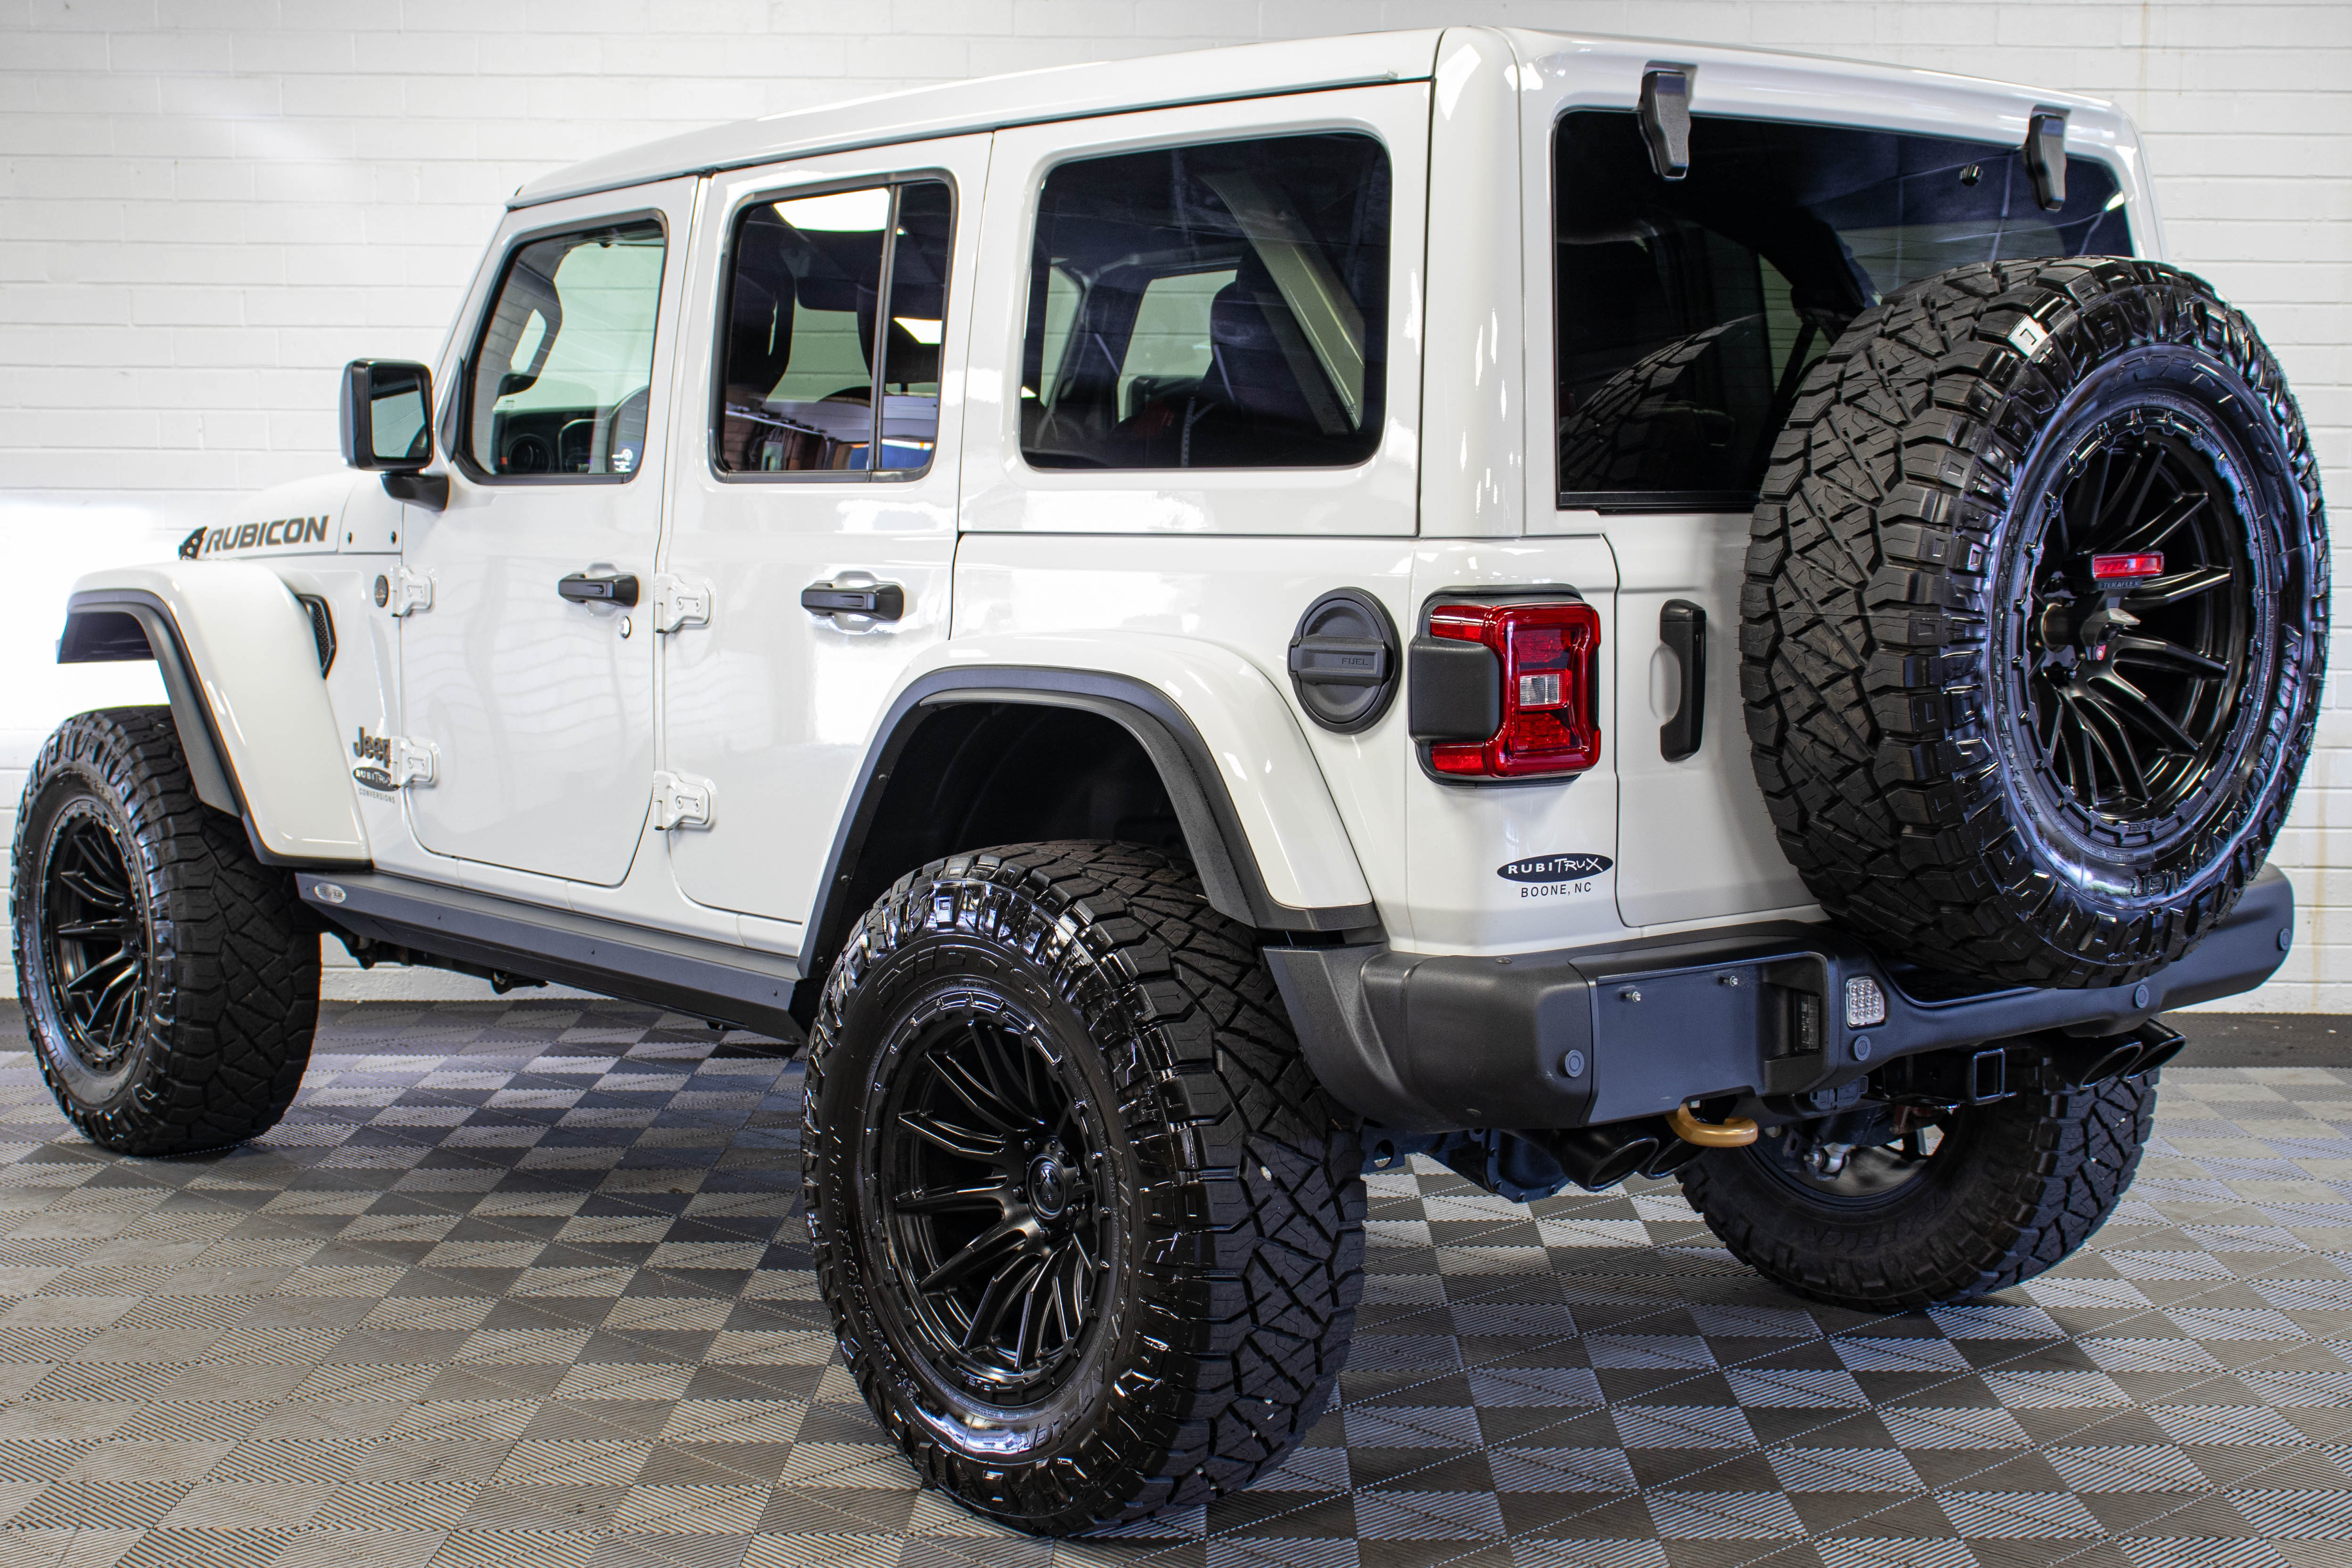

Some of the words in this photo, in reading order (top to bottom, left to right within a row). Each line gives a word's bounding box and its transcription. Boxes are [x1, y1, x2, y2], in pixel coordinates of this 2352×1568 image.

[206, 515, 329, 553] RUBICON
[2104, 580, 2138, 588] TERAFLEX
[2258, 623, 2303, 773] RIDGE
[353, 726, 391, 768] Jeep
[355, 769, 392, 787] RUBITRU
[359, 788, 395, 803] CONVERSIONS
[2130, 762, 2268, 897] GRAPPLER
[1508, 858, 1603, 874] RUBITRUX
[1521, 884, 1570, 898] BOONE,
[1575, 882, 1591, 893] NC
